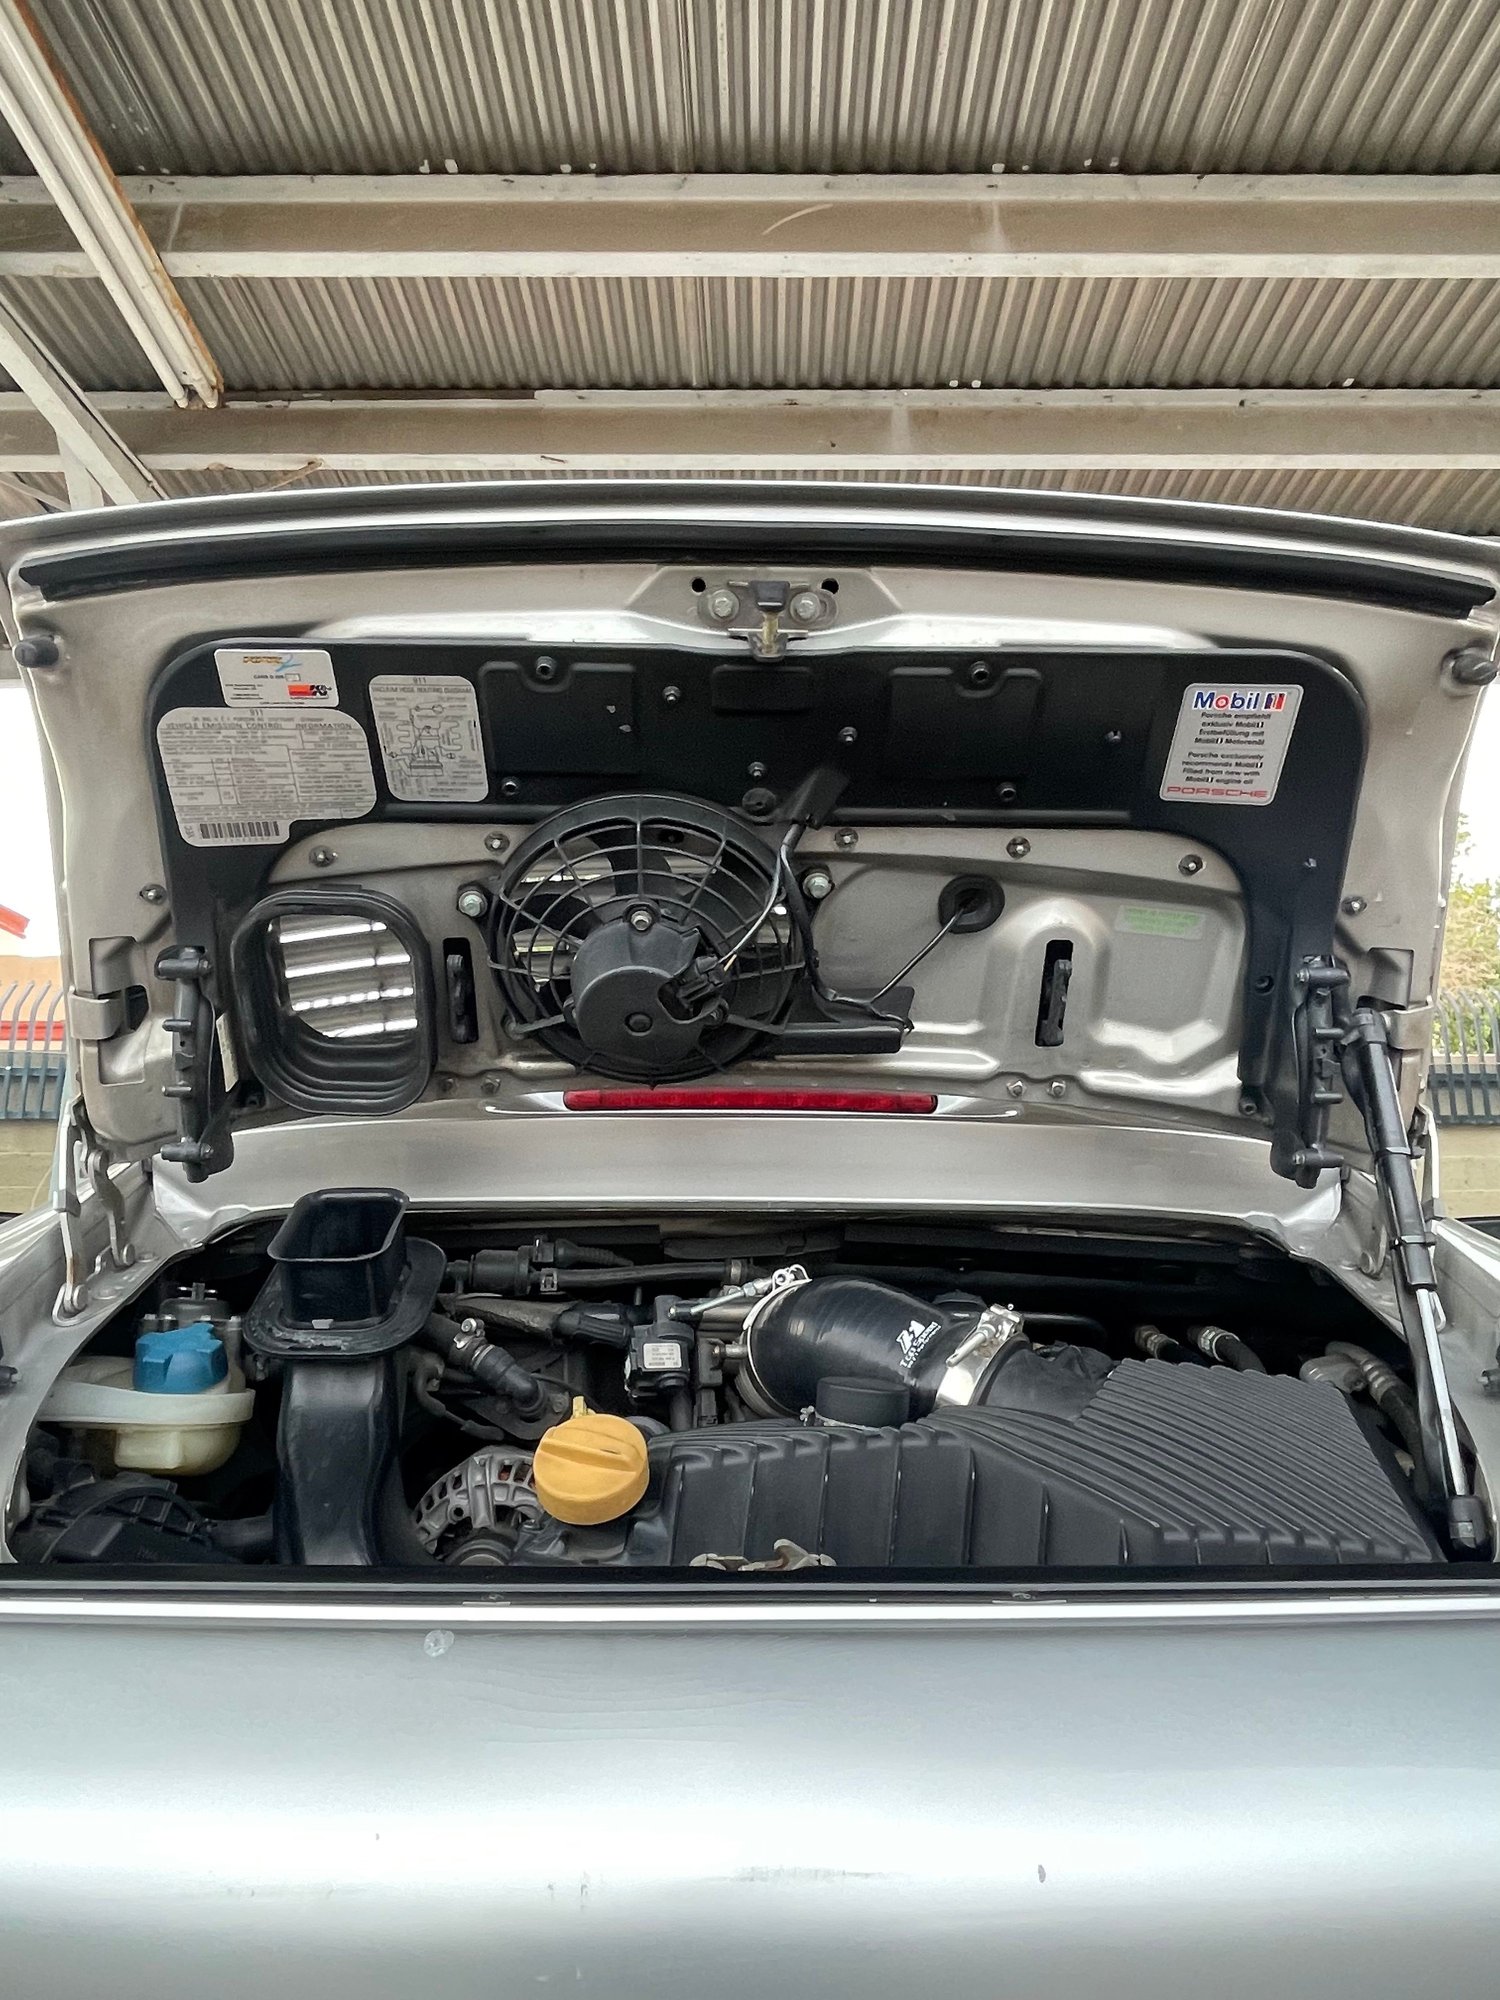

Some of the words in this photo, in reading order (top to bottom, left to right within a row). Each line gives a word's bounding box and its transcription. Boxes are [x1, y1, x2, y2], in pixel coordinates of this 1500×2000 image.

[1193, 691, 1260, 709] Mobil
[1200, 711, 1232, 719] Porsche
[1187, 751, 1219, 759] Porsche
[1166, 786, 1268, 798] PORSCHE
